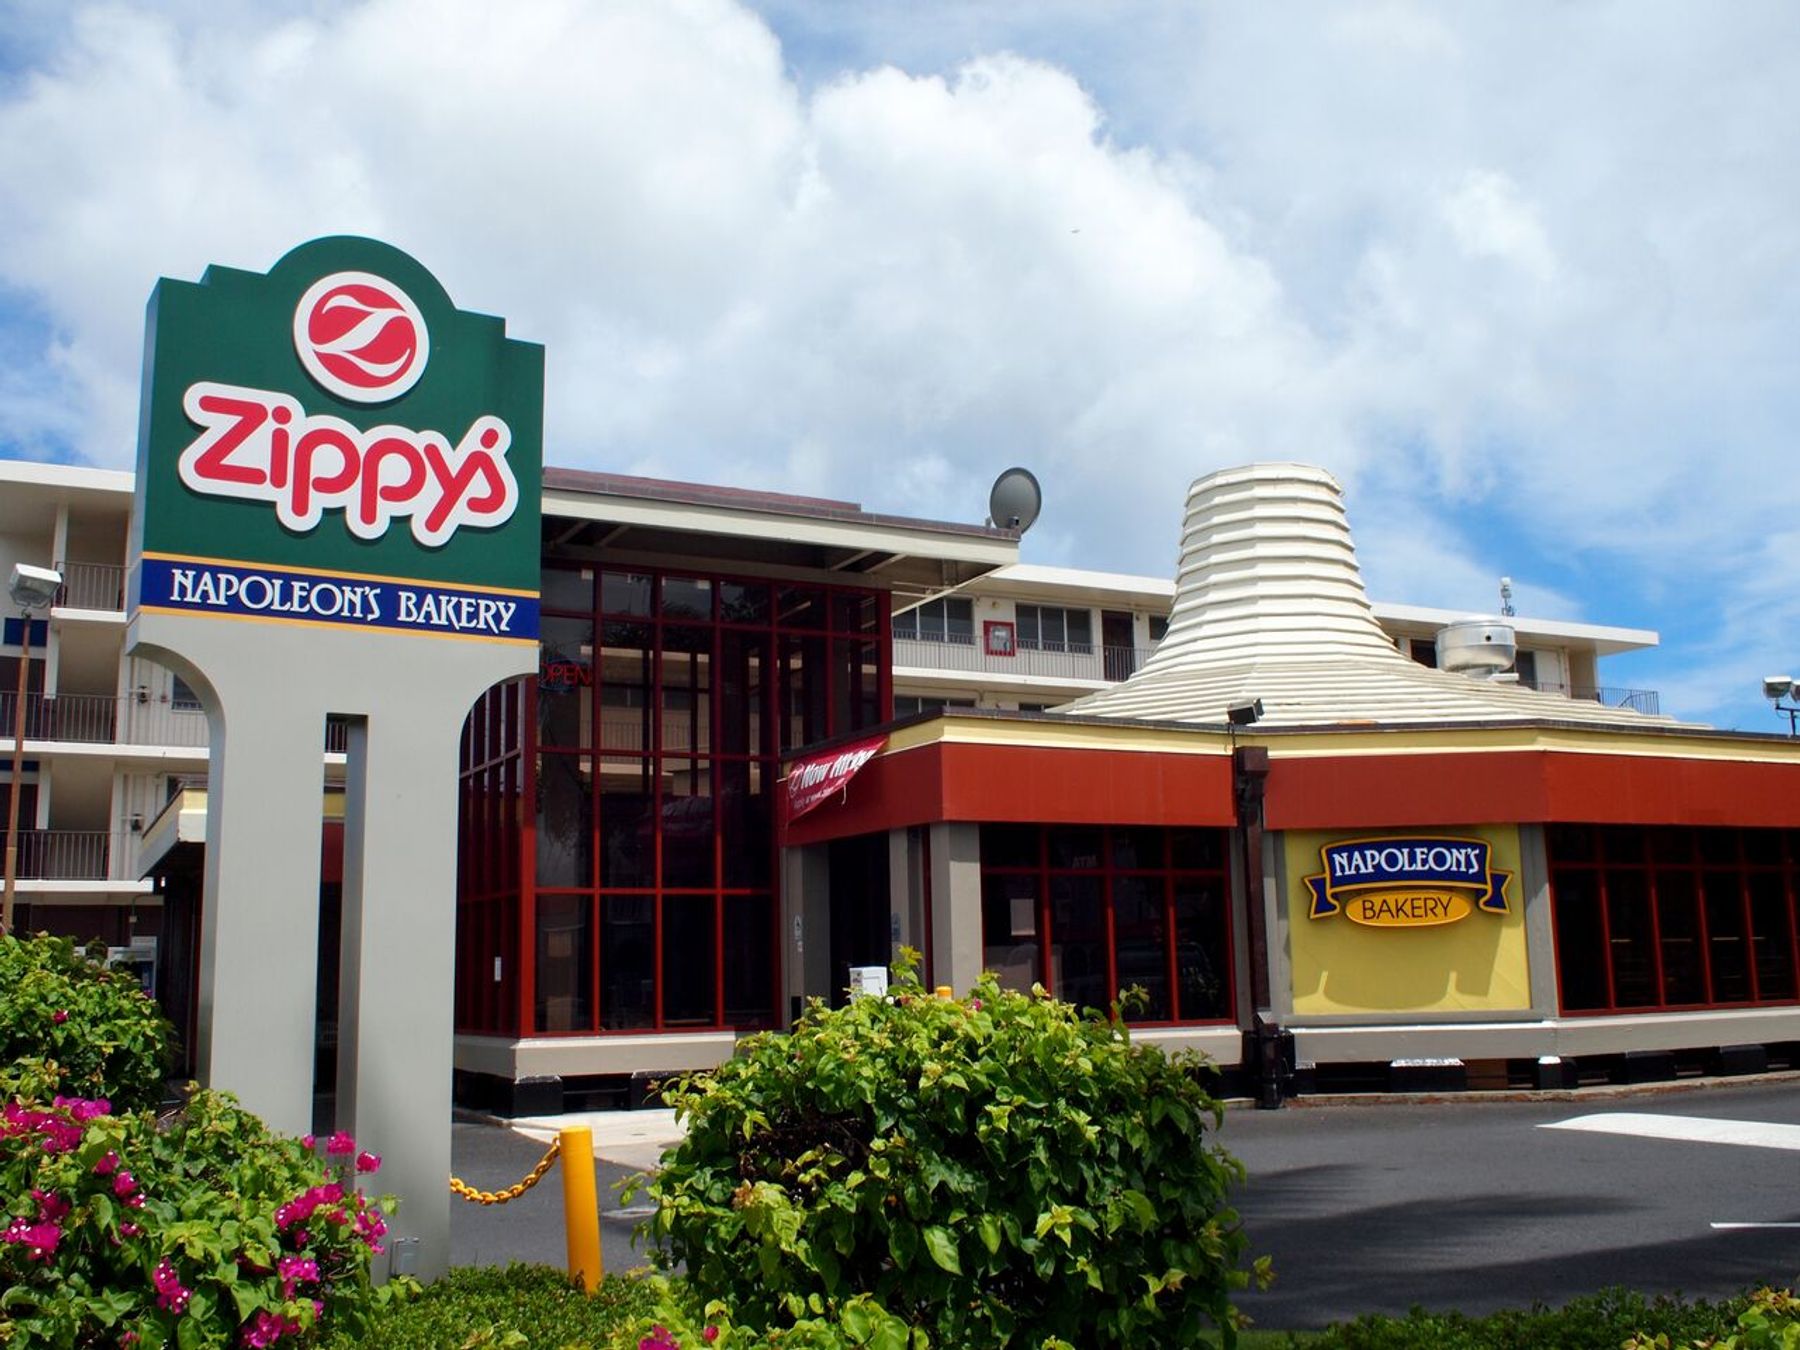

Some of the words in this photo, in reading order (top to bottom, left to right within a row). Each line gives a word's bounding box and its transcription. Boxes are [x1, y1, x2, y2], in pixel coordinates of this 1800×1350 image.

[170, 568, 381, 622] NAPOLEON'S
[397, 591, 517, 634] BAKERY
[1332, 847, 1480, 877] NAPOLEON'S
[1362, 896, 1453, 920] BAKERY
